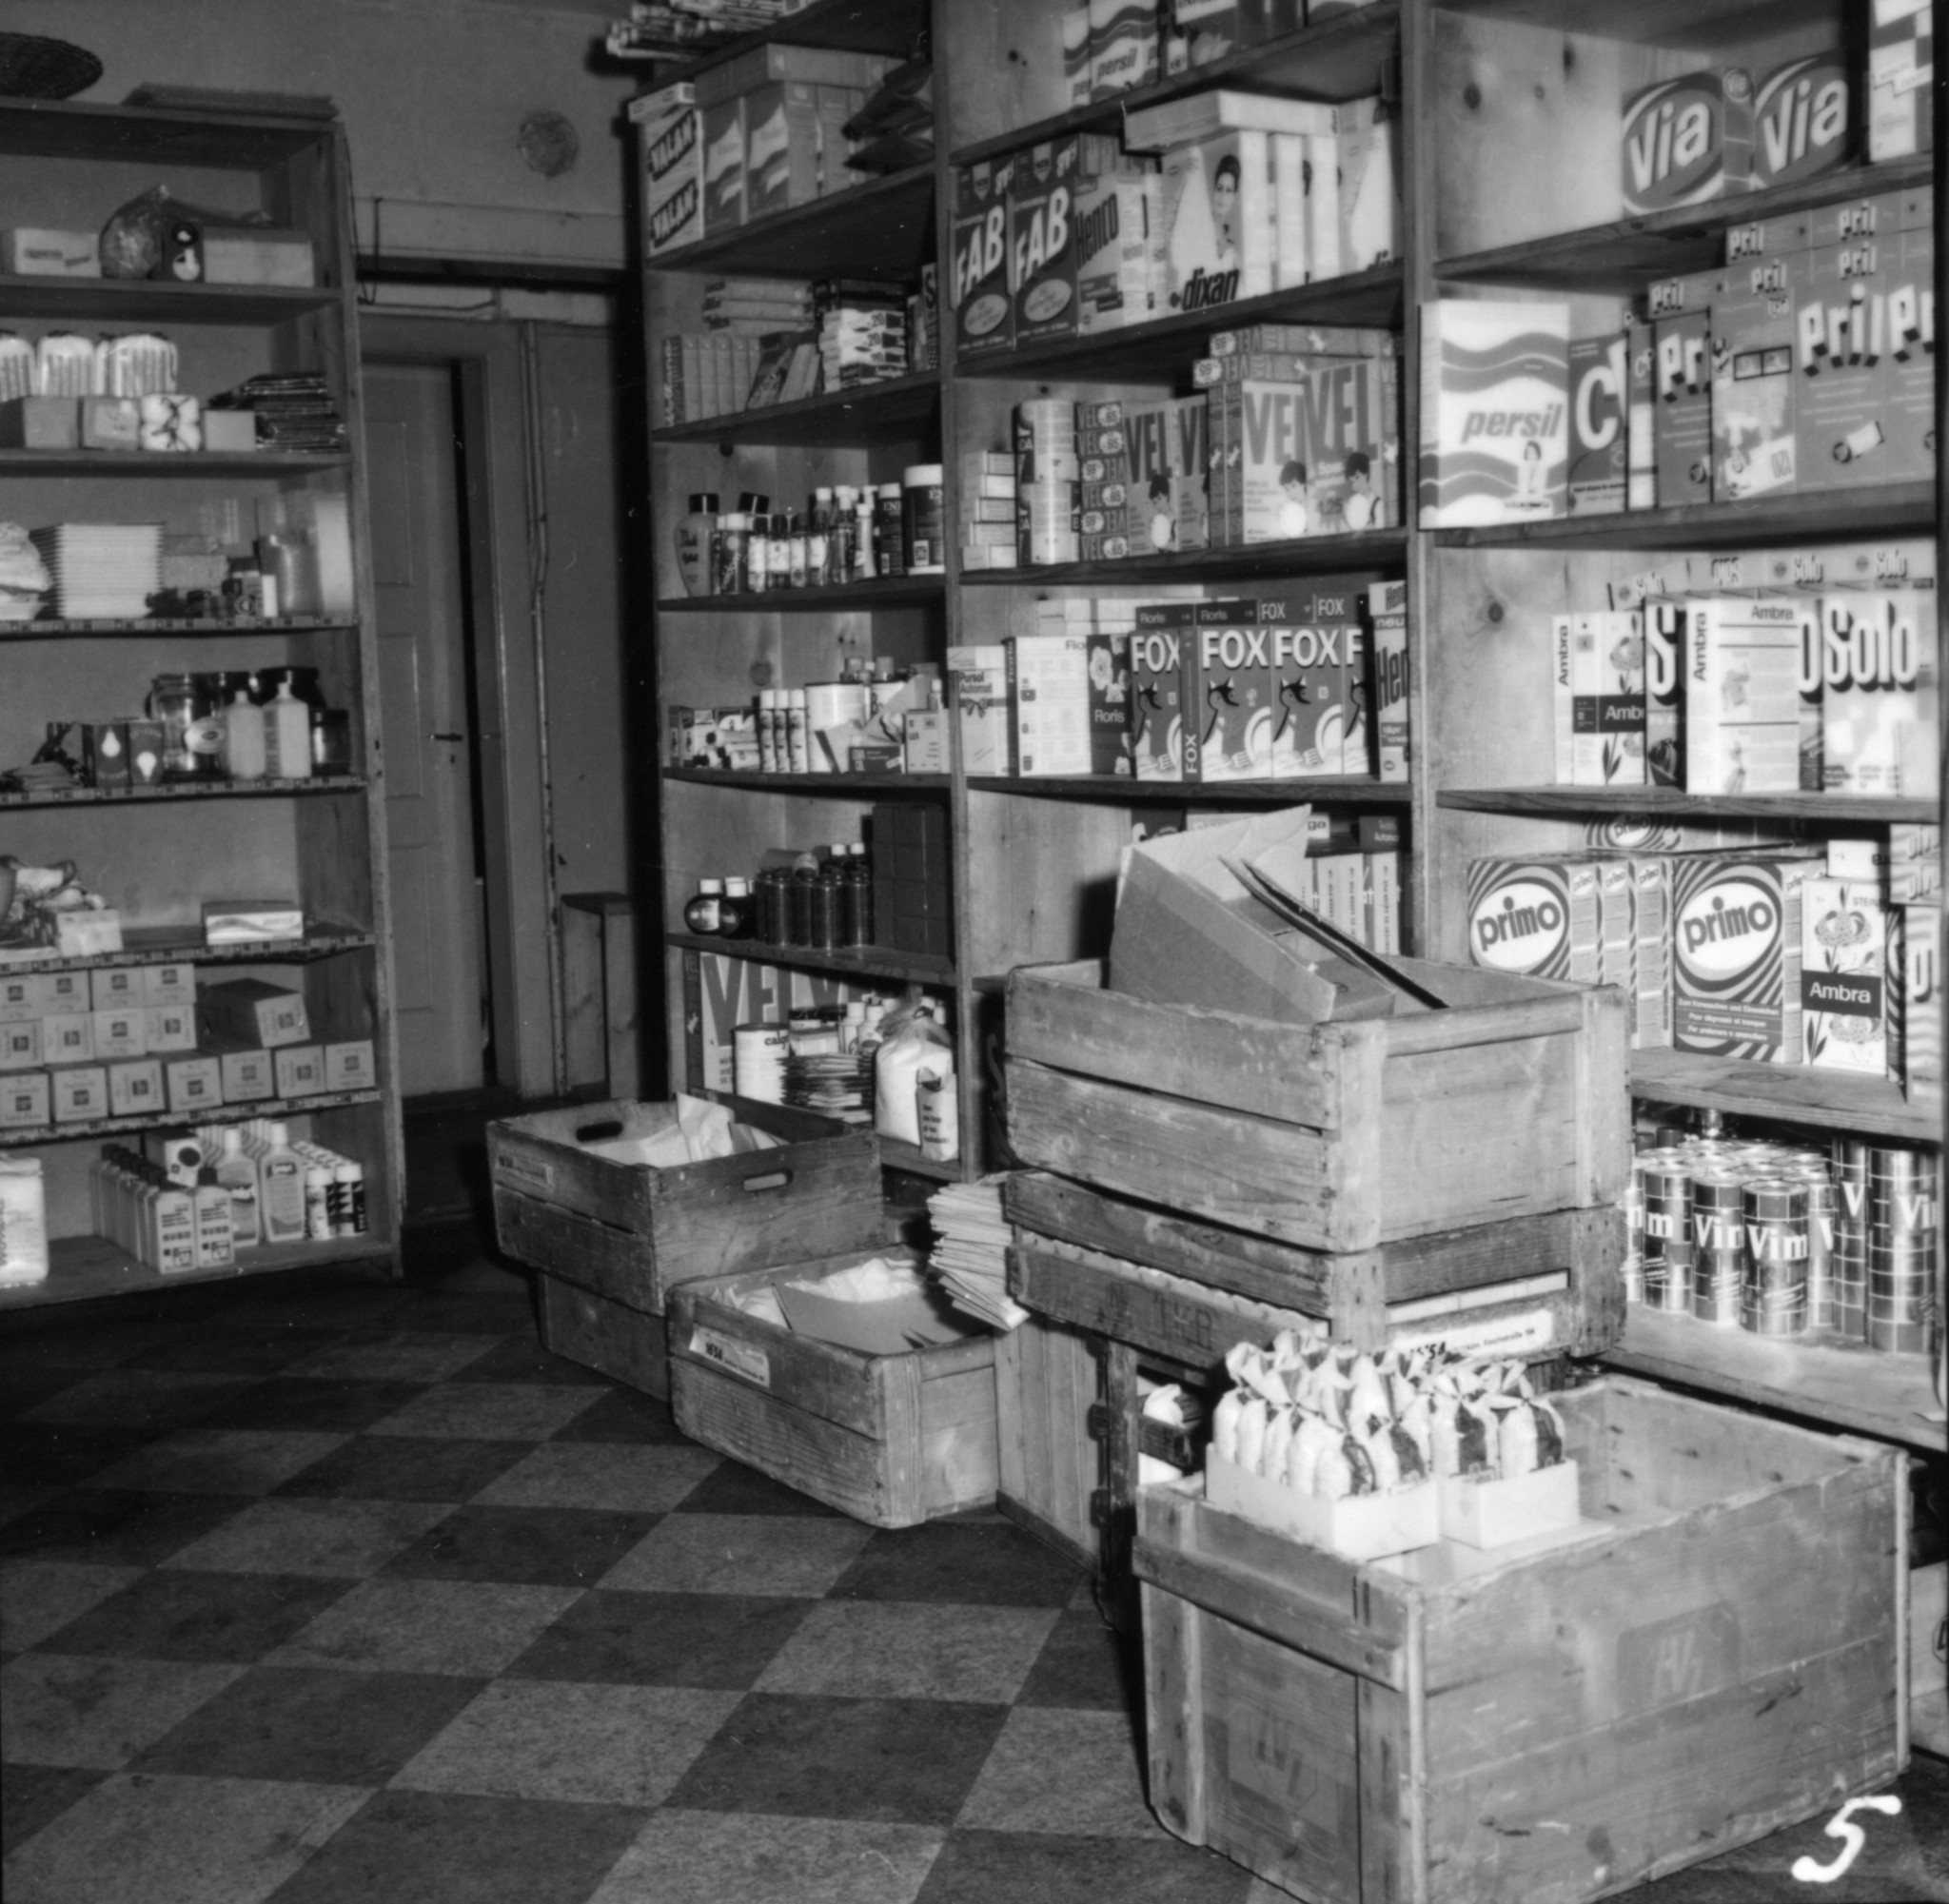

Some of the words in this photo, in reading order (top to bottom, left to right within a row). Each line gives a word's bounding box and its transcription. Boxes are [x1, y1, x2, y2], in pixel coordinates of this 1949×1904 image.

[1097, 48, 1138, 83] persil
[1762, 79, 1849, 174] Via
[1629, 103, 1710, 192] Via
[955, 204, 1005, 309] FAB
[1015, 186, 1070, 291] FAB
[1183, 266, 1240, 310] dixan
[1302, 363, 1379, 464] VEL
[1459, 402, 1563, 444] persil
[1125, 410, 1173, 484] VEL
[1140, 613, 1166, 624] Floris
[1201, 610, 1229, 620] Floris
[1261, 602, 1285, 619] FOX
[1318, 598, 1345, 617] FOX
[1751, 605, 1795, 621] Ambra
[1130, 632, 1181, 673] FOX
[1202, 628, 1270, 670] FOX
[1275, 628, 1341, 669] FOX
[1557, 624, 1570, 687] Ambra
[1693, 612, 1707, 683] Ambra
[1824, 601, 1918, 693] Solo
[1094, 709, 1125, 723] Floris
[1185, 734, 1197, 774] FOX
[1614, 815, 1649, 839] primo
[1639, 866, 1661, 886] primo
[1477, 895, 1562, 952] primo
[1683, 896, 1774, 952] primo
[1809, 982, 1872, 1004] Ambra
[1746, 1224, 1808, 1260] Vim
